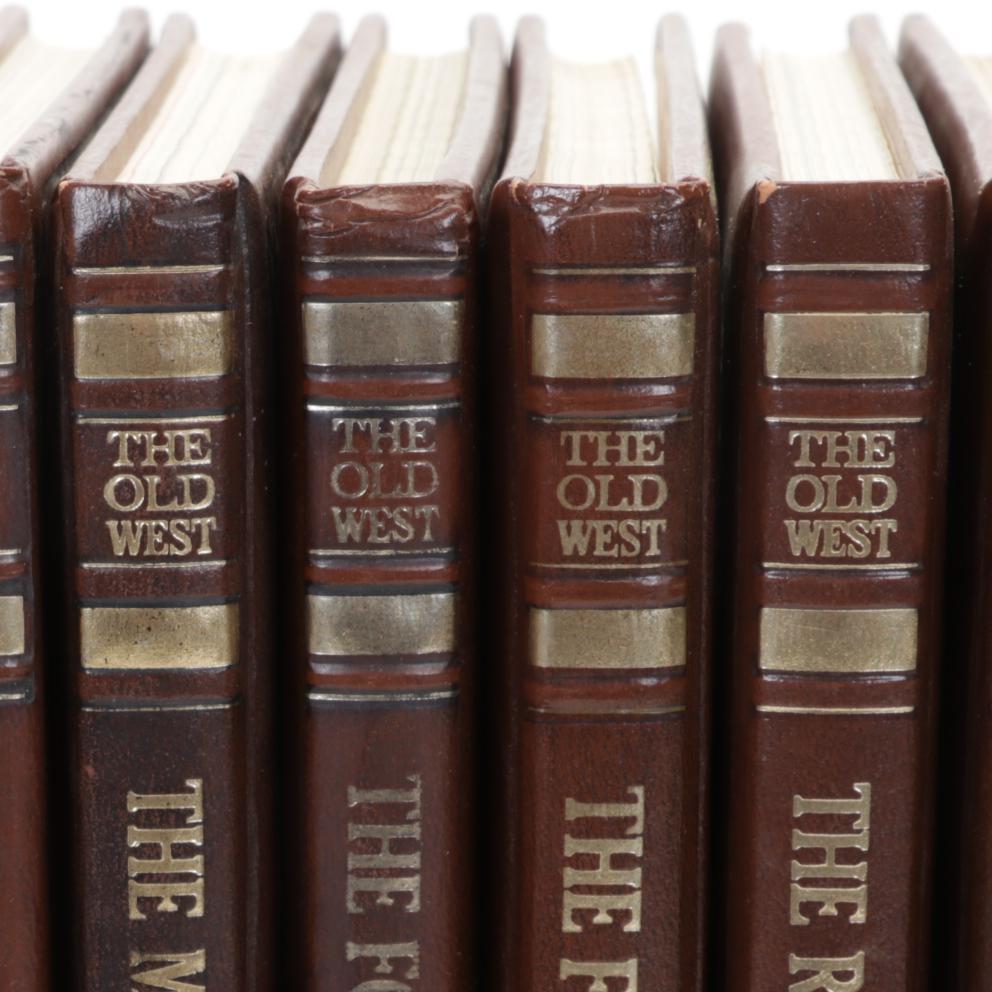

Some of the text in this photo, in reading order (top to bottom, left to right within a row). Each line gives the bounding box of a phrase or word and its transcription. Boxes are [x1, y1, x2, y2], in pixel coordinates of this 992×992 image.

[110, 430, 213, 468] THE
[331, 417, 437, 454] THE
[561, 432, 665, 467] THE
[788, 430, 895, 468] THE
[104, 473, 216, 512] OLD
[331, 461, 439, 500] OLD
[557, 474, 668, 512] OLD
[785, 474, 897, 512] OLD
[106, 518, 217, 557] WEST
[332, 506, 438, 544] WEST
[556, 518, 666, 558] WEST
[784, 518, 897, 559] WEST
[126, 779, 204, 921] THE
[346, 773, 422, 914] THE
[561, 785, 646, 933] THE
[789, 782, 872, 926] THE
